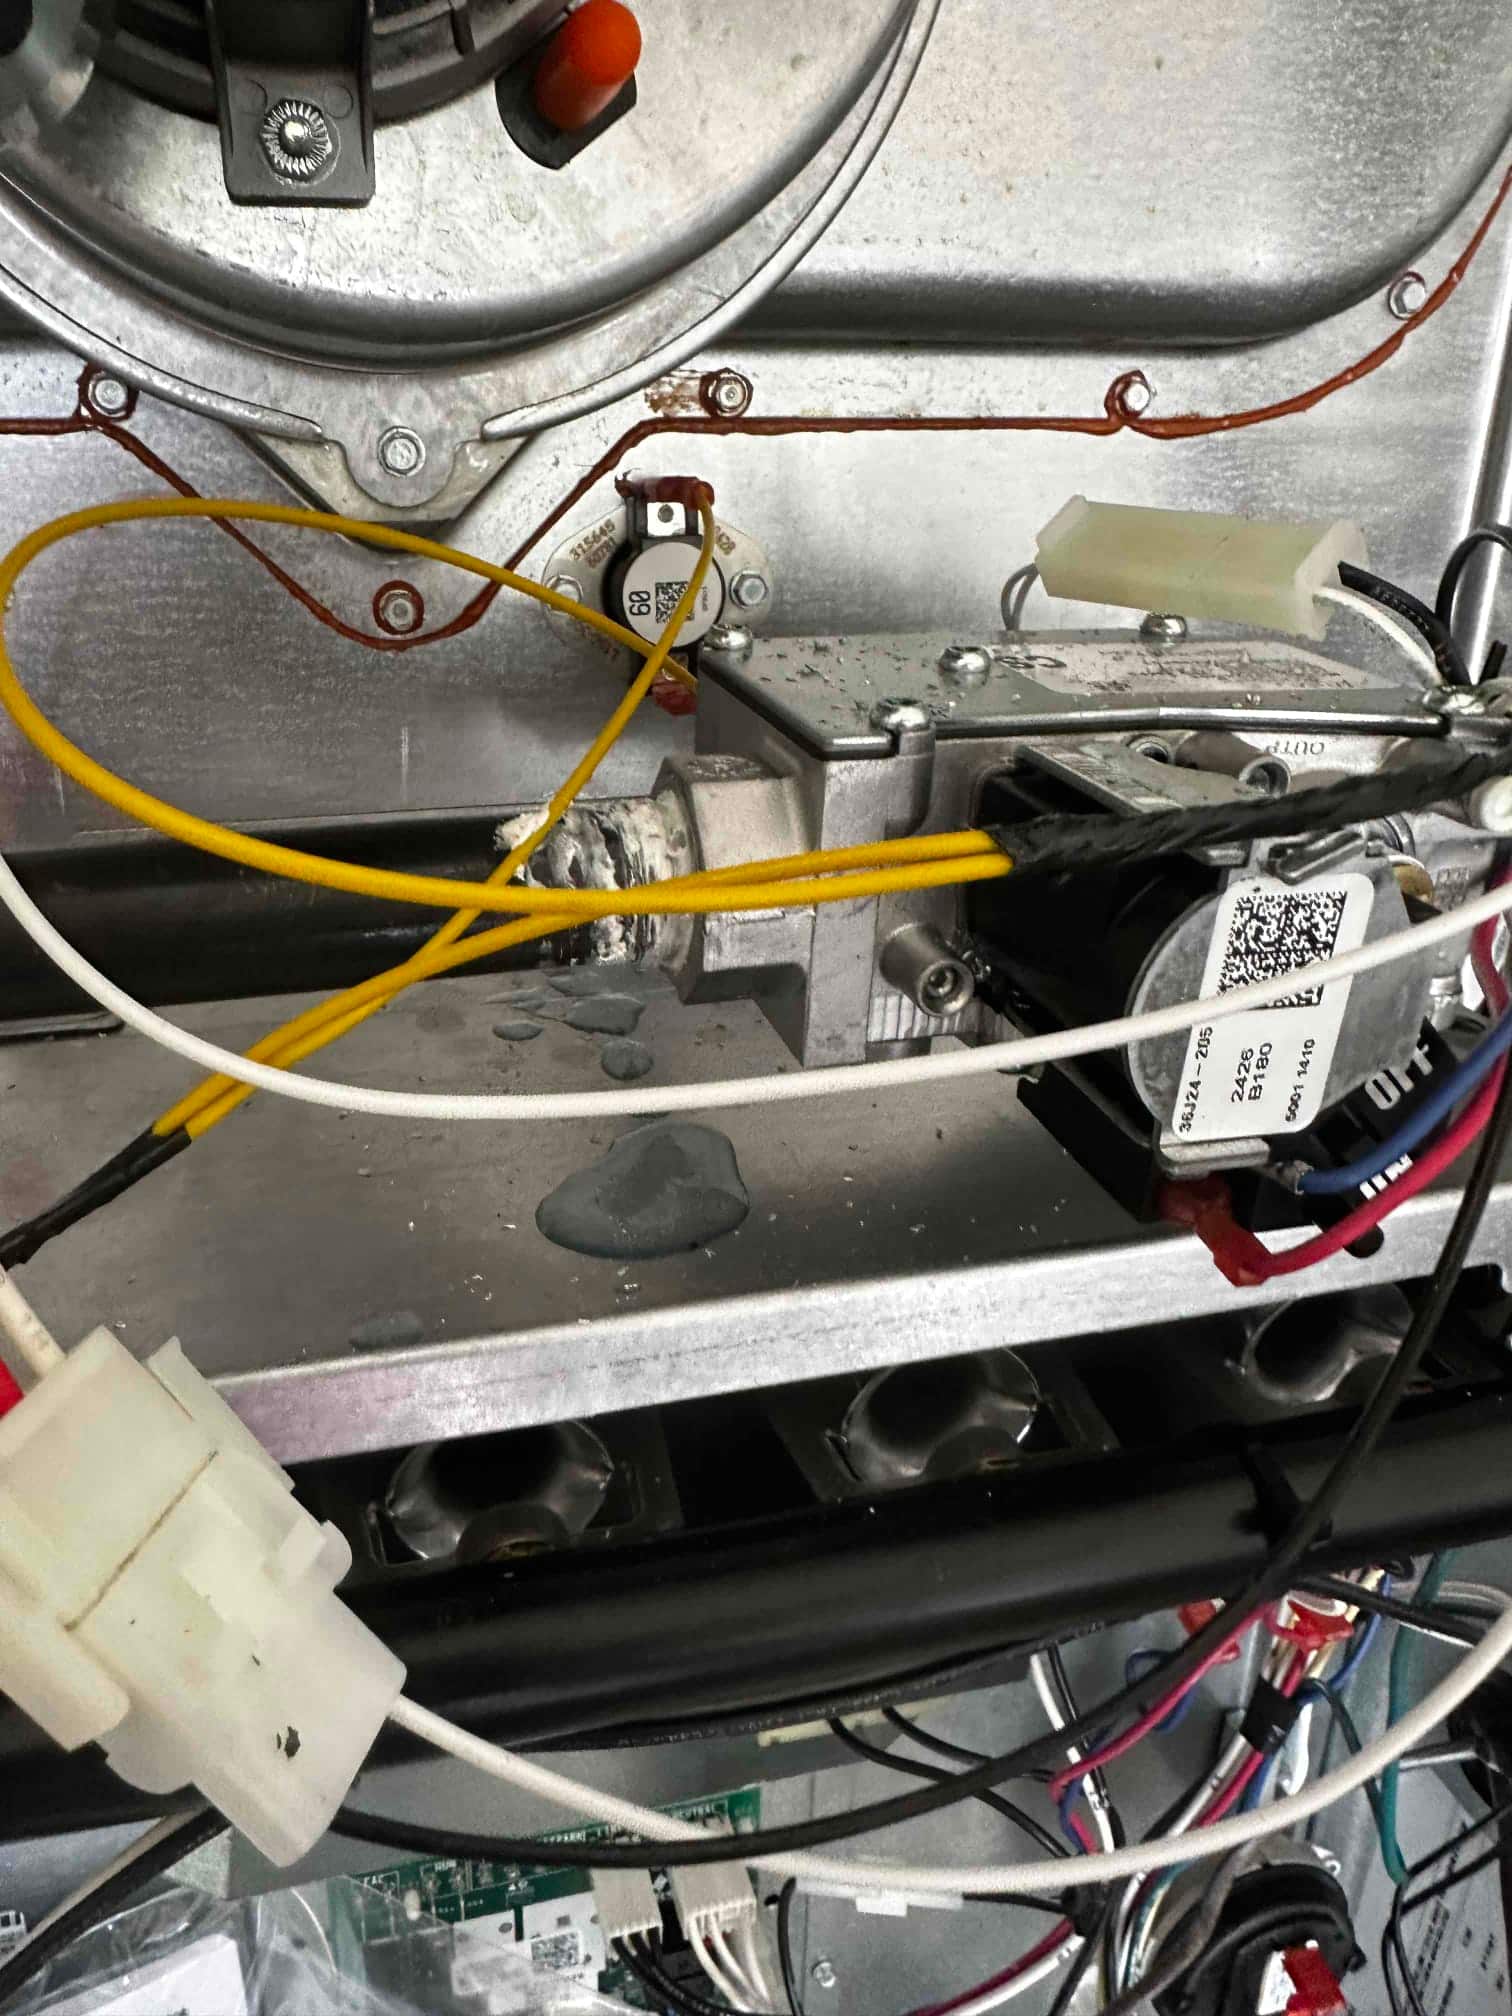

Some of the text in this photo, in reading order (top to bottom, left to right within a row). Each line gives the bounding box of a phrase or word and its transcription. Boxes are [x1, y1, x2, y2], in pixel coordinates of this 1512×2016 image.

[629, 590, 651, 616] 60
[1231, 1047, 1254, 1104] 2426
[1248, 1042, 1273, 1101] B180
[1297, 1039, 1315, 1080] 1410
